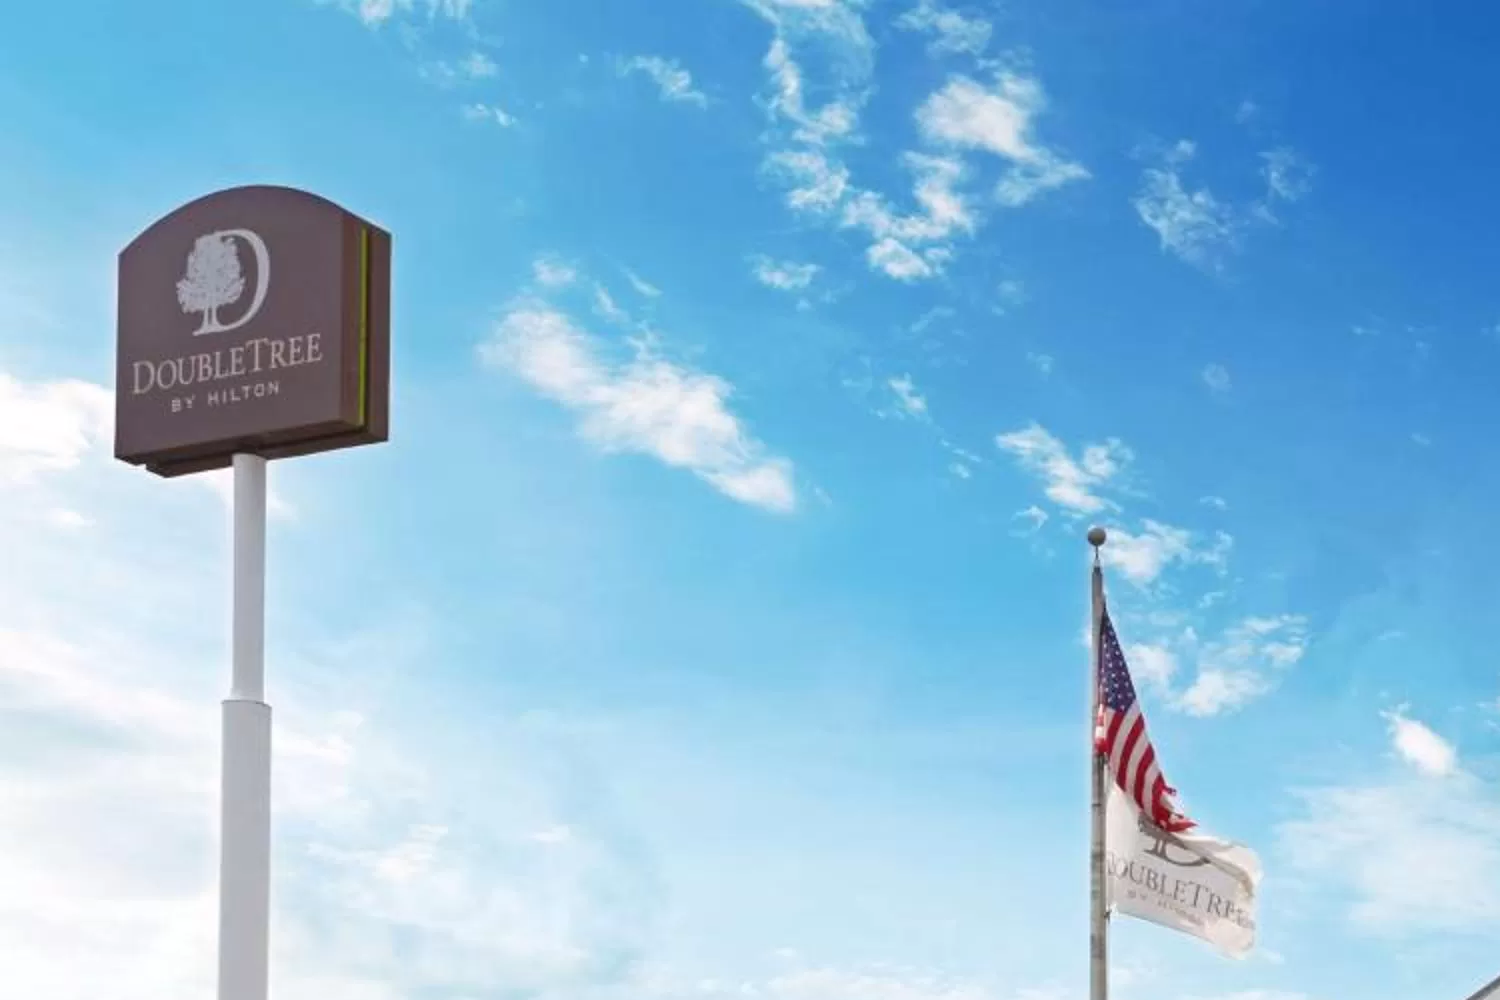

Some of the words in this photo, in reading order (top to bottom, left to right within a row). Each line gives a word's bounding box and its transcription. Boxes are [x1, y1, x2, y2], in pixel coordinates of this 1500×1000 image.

[132, 333, 323, 395] DOUBLETREE
[171, 395, 195, 413] BY
[207, 381, 280, 407] HILTON
